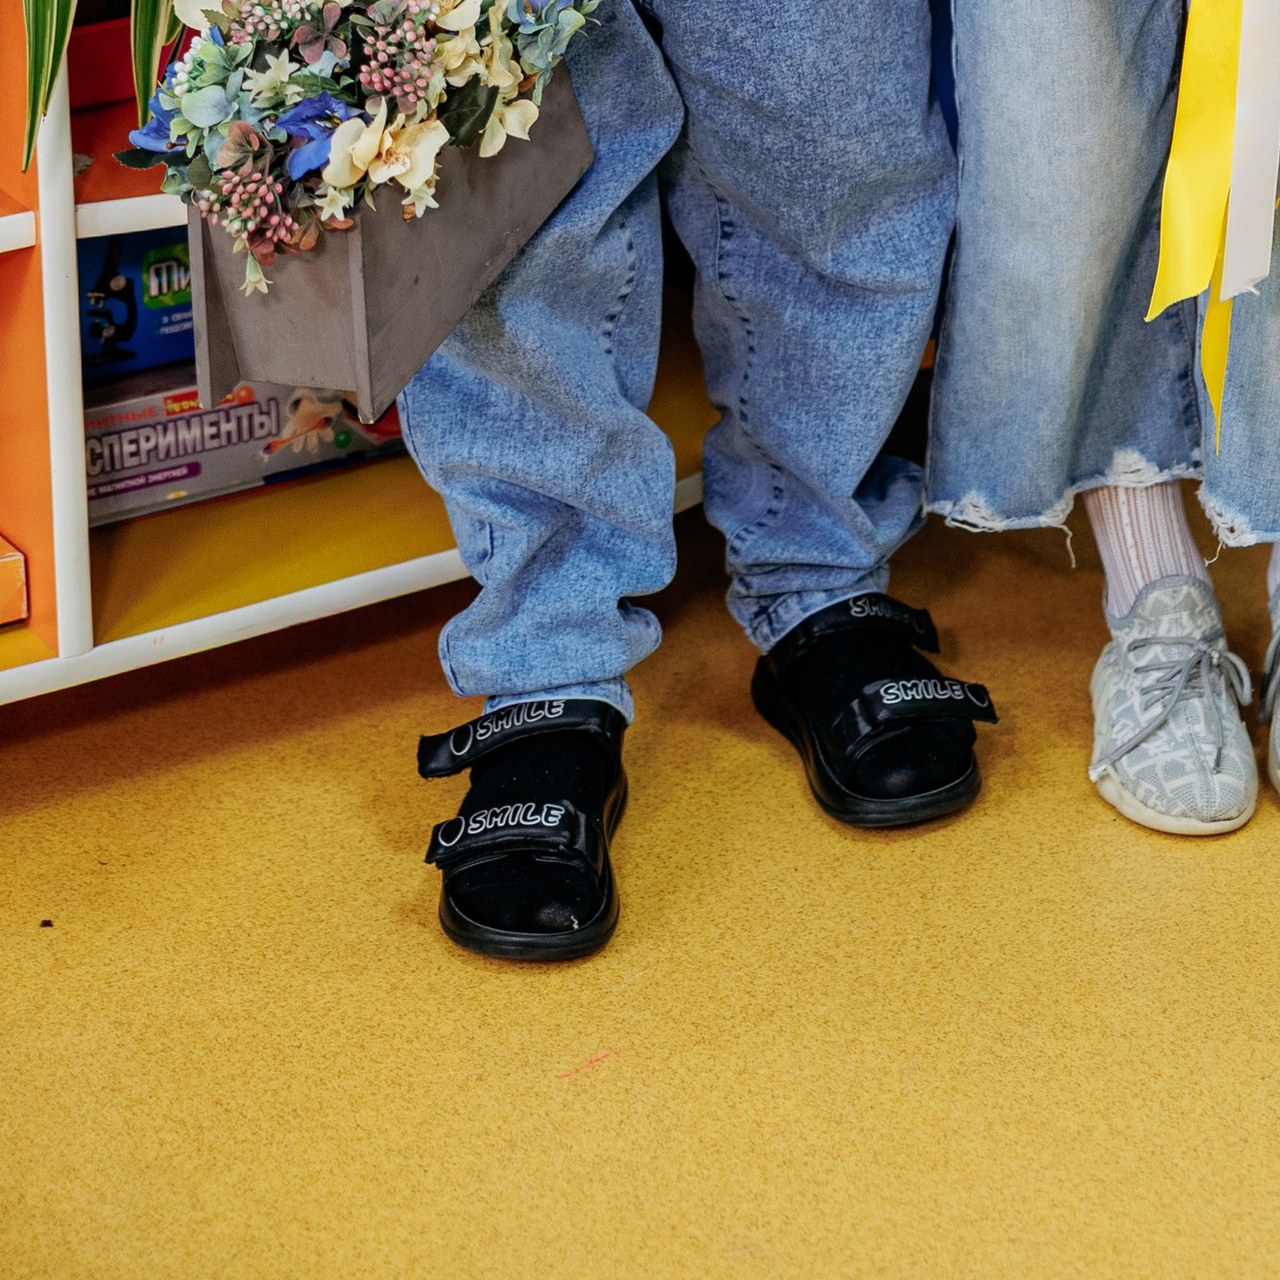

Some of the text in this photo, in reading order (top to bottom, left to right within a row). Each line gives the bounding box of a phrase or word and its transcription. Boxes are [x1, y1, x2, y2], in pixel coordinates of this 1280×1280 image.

[86, 399, 280, 475] СПЕРИМЕНТЫ
[879, 679, 965, 704] SMILE
[476, 699, 566, 740] SMILE
[467, 802, 566, 834] SMILE
